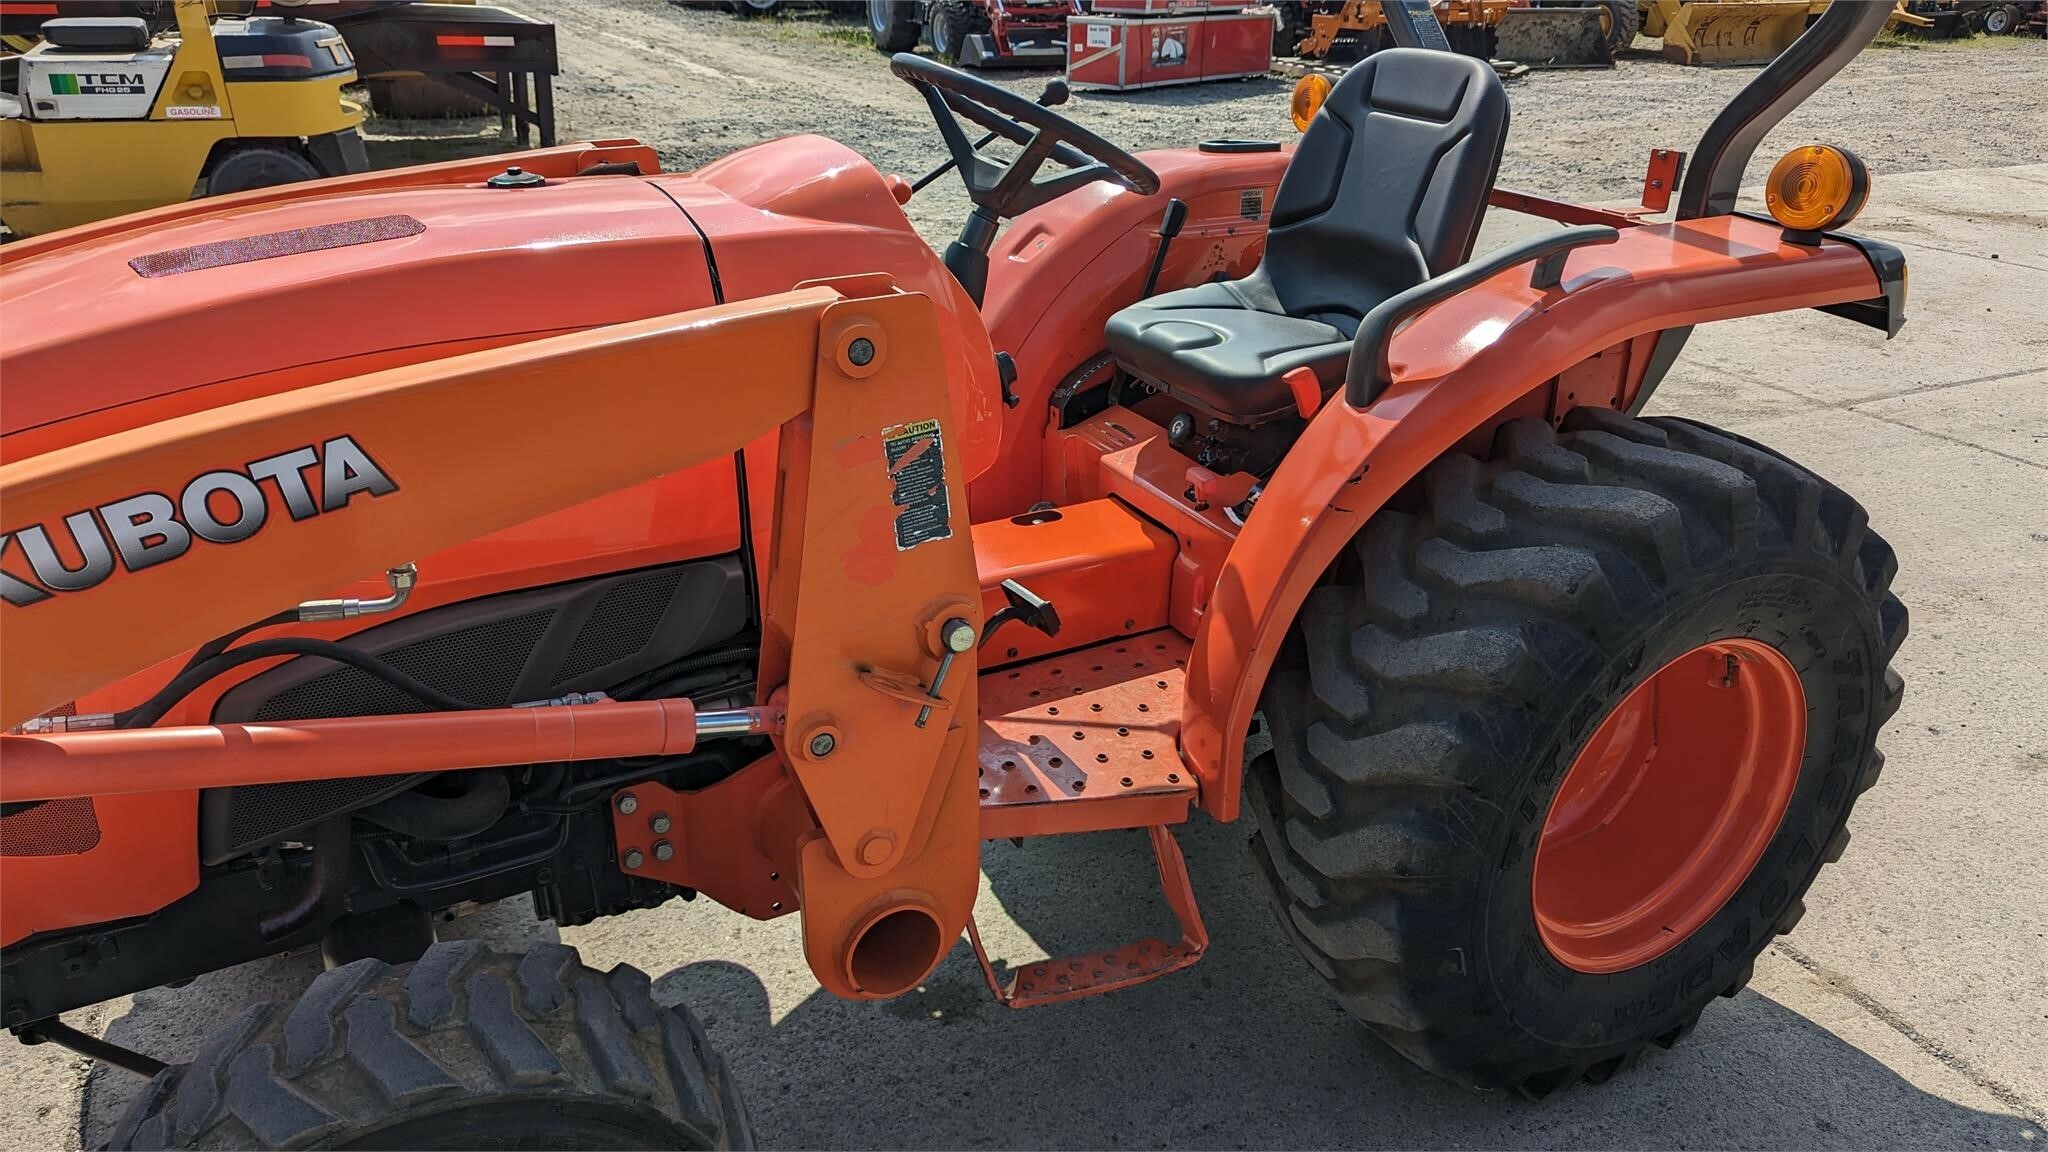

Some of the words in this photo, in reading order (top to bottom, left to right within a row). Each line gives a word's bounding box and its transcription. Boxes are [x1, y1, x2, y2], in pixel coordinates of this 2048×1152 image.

[77, 74, 144, 84] TCM
[170, 107, 217, 116] GASOLINE
[897, 421, 936, 437] AUTION
